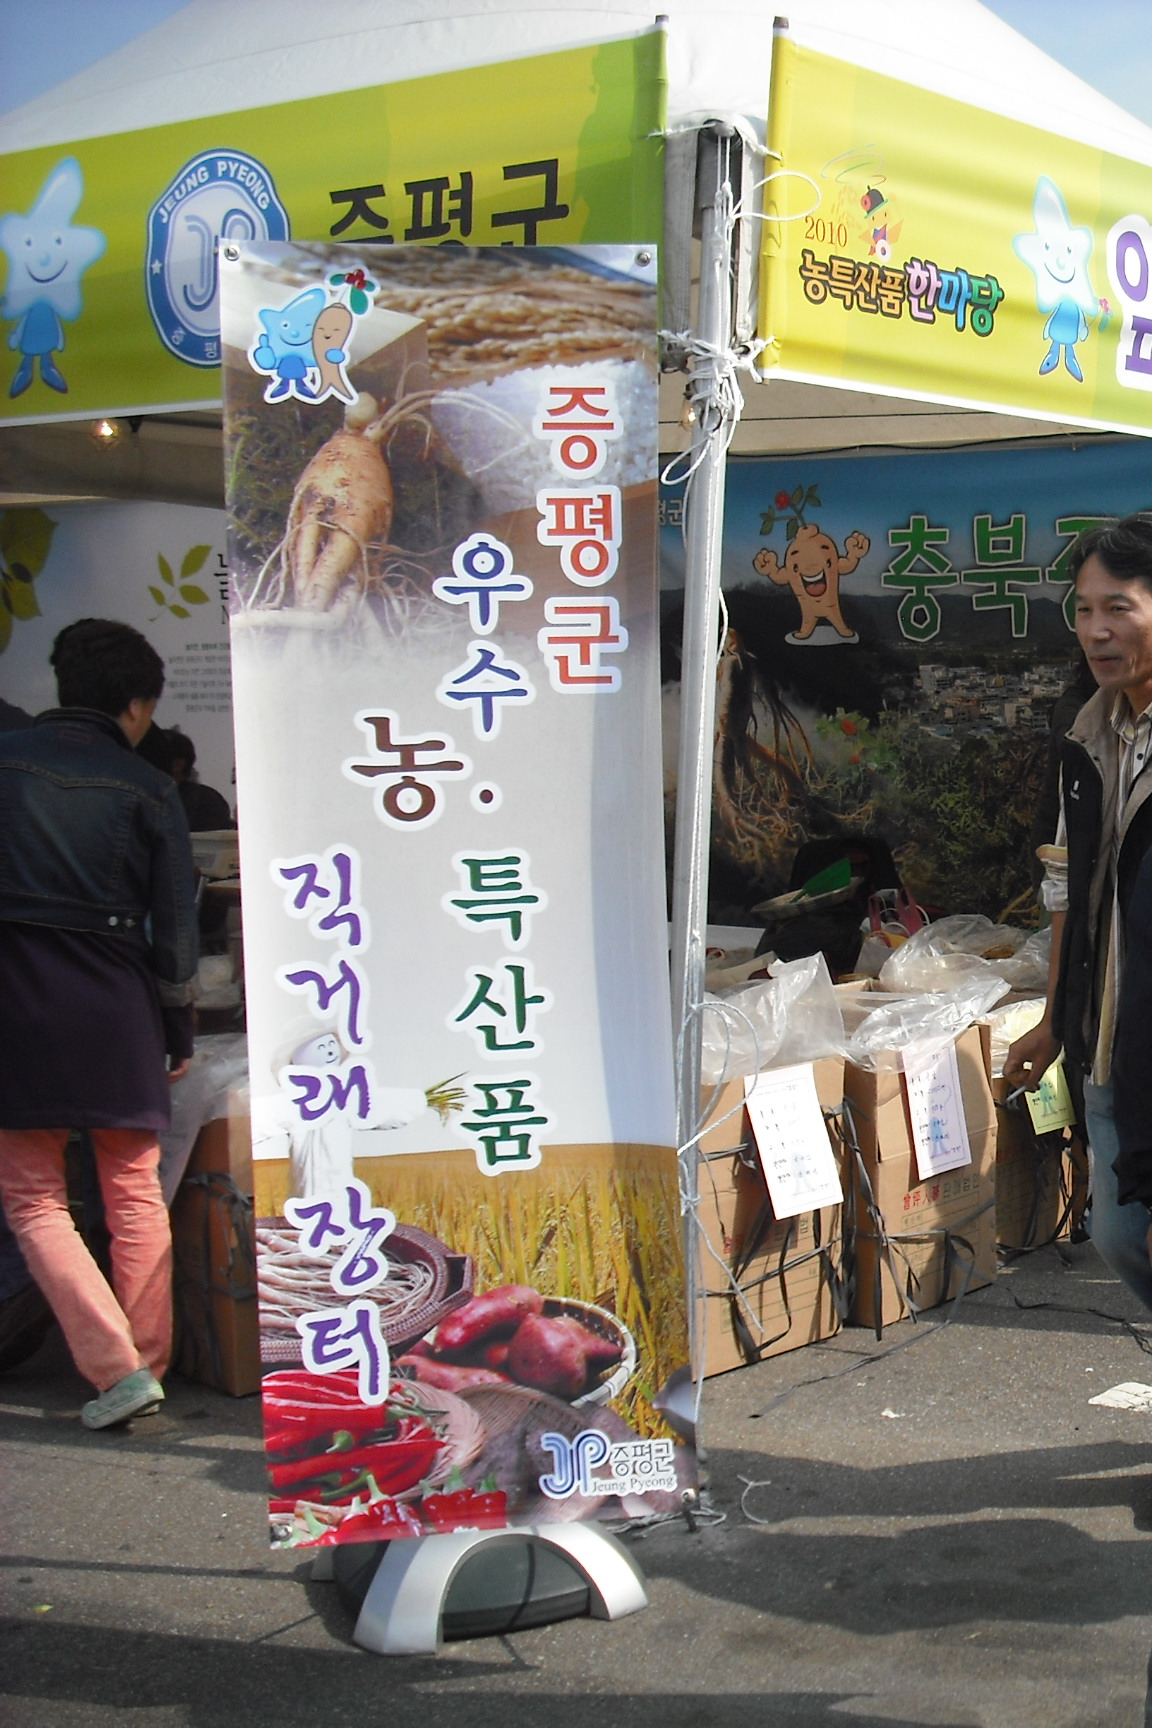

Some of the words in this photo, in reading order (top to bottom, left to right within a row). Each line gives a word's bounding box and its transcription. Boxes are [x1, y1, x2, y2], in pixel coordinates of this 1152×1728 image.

[159, 165, 209, 223] JEUNG
[217, 160, 270, 210] PYEONG
[803, 215, 848, 248] 2010
[541, 386, 621, 686] 증평군
[441, 541, 529, 733] 우수
[612, 1442, 671, 1477] 증평군
[592, 1480, 627, 1493] Jeung
[630, 1476, 673, 1491] Pyeong
